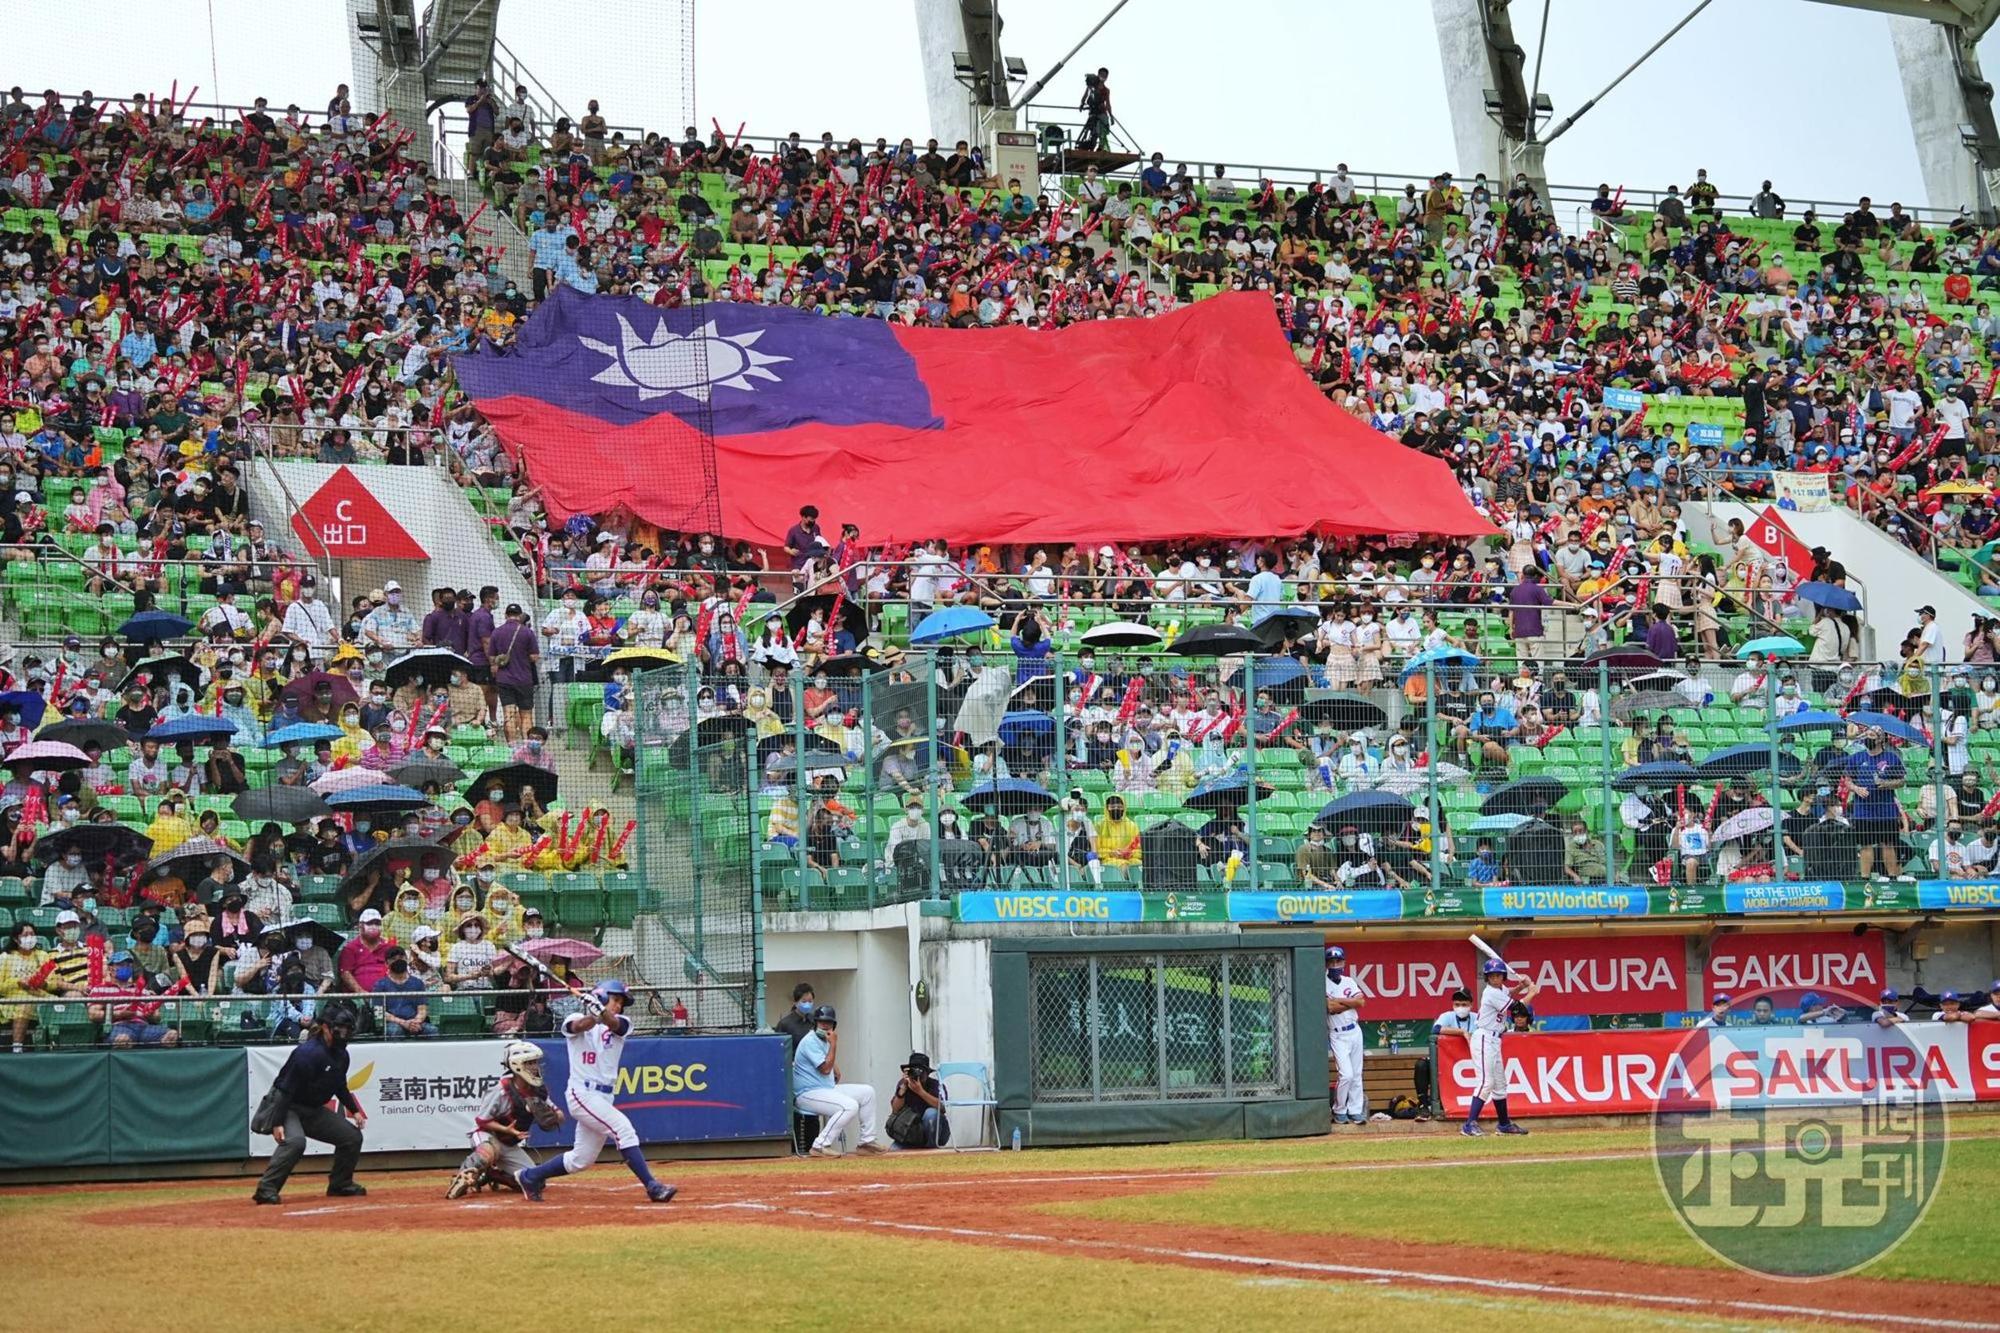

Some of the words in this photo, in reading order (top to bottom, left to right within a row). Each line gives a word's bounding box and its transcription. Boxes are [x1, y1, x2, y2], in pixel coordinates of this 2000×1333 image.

[336, 499, 353, 522] C
[323, 524, 367, 545] 出口
[1765, 526, 1778, 544] B
[1502, 890, 1629, 912] #U12WorldCup
[1743, 897, 1779, 909] WORLD
[1780, 896, 1828, 907] CHAMPION
[1744, 887, 1765, 898] FOR
[1767, 886, 1785, 898] THE
[1785, 886, 1810, 897] TITLE
[1810, 885, 1823, 896] OF
[994, 896, 1109, 918] WBSC.ORG
[1276, 894, 1354, 920] @WBSC
[1349, 962, 1465, 999] KURA
[1507, 957, 1678, 995] SAKURA
[1711, 952, 1877, 989] SAKURA
[582, 1051, 597, 1065] 18
[614, 1063, 708, 1095] WBSC
[1452, 1053, 1701, 1106] SAKURA
[1724, 1045, 1959, 1097] SAKURA
[380, 1104, 414, 1115] Tainan
[416, 1104, 436, 1116] City
[438, 1103, 482, 1114] Governm
